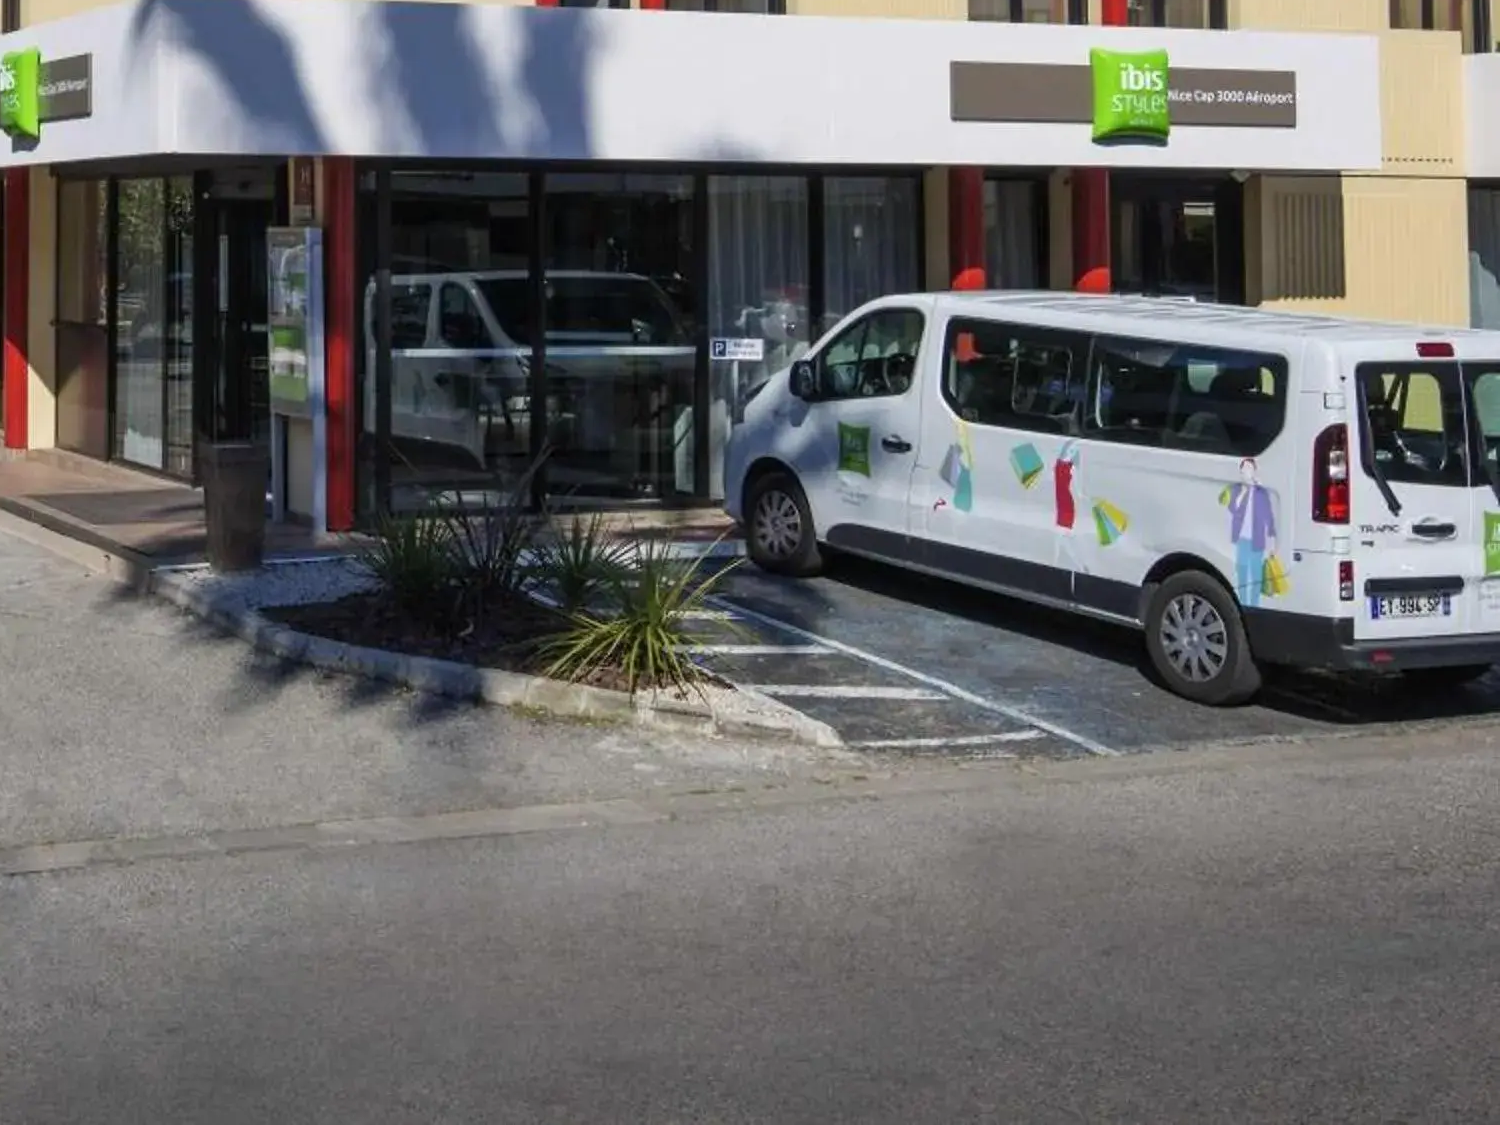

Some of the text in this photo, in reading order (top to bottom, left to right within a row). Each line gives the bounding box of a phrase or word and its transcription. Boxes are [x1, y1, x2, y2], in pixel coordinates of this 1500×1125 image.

[1119, 62, 1165, 91] ibis
[1194, 90, 1215, 103] Cap
[1217, 90, 1244, 103] 3000
